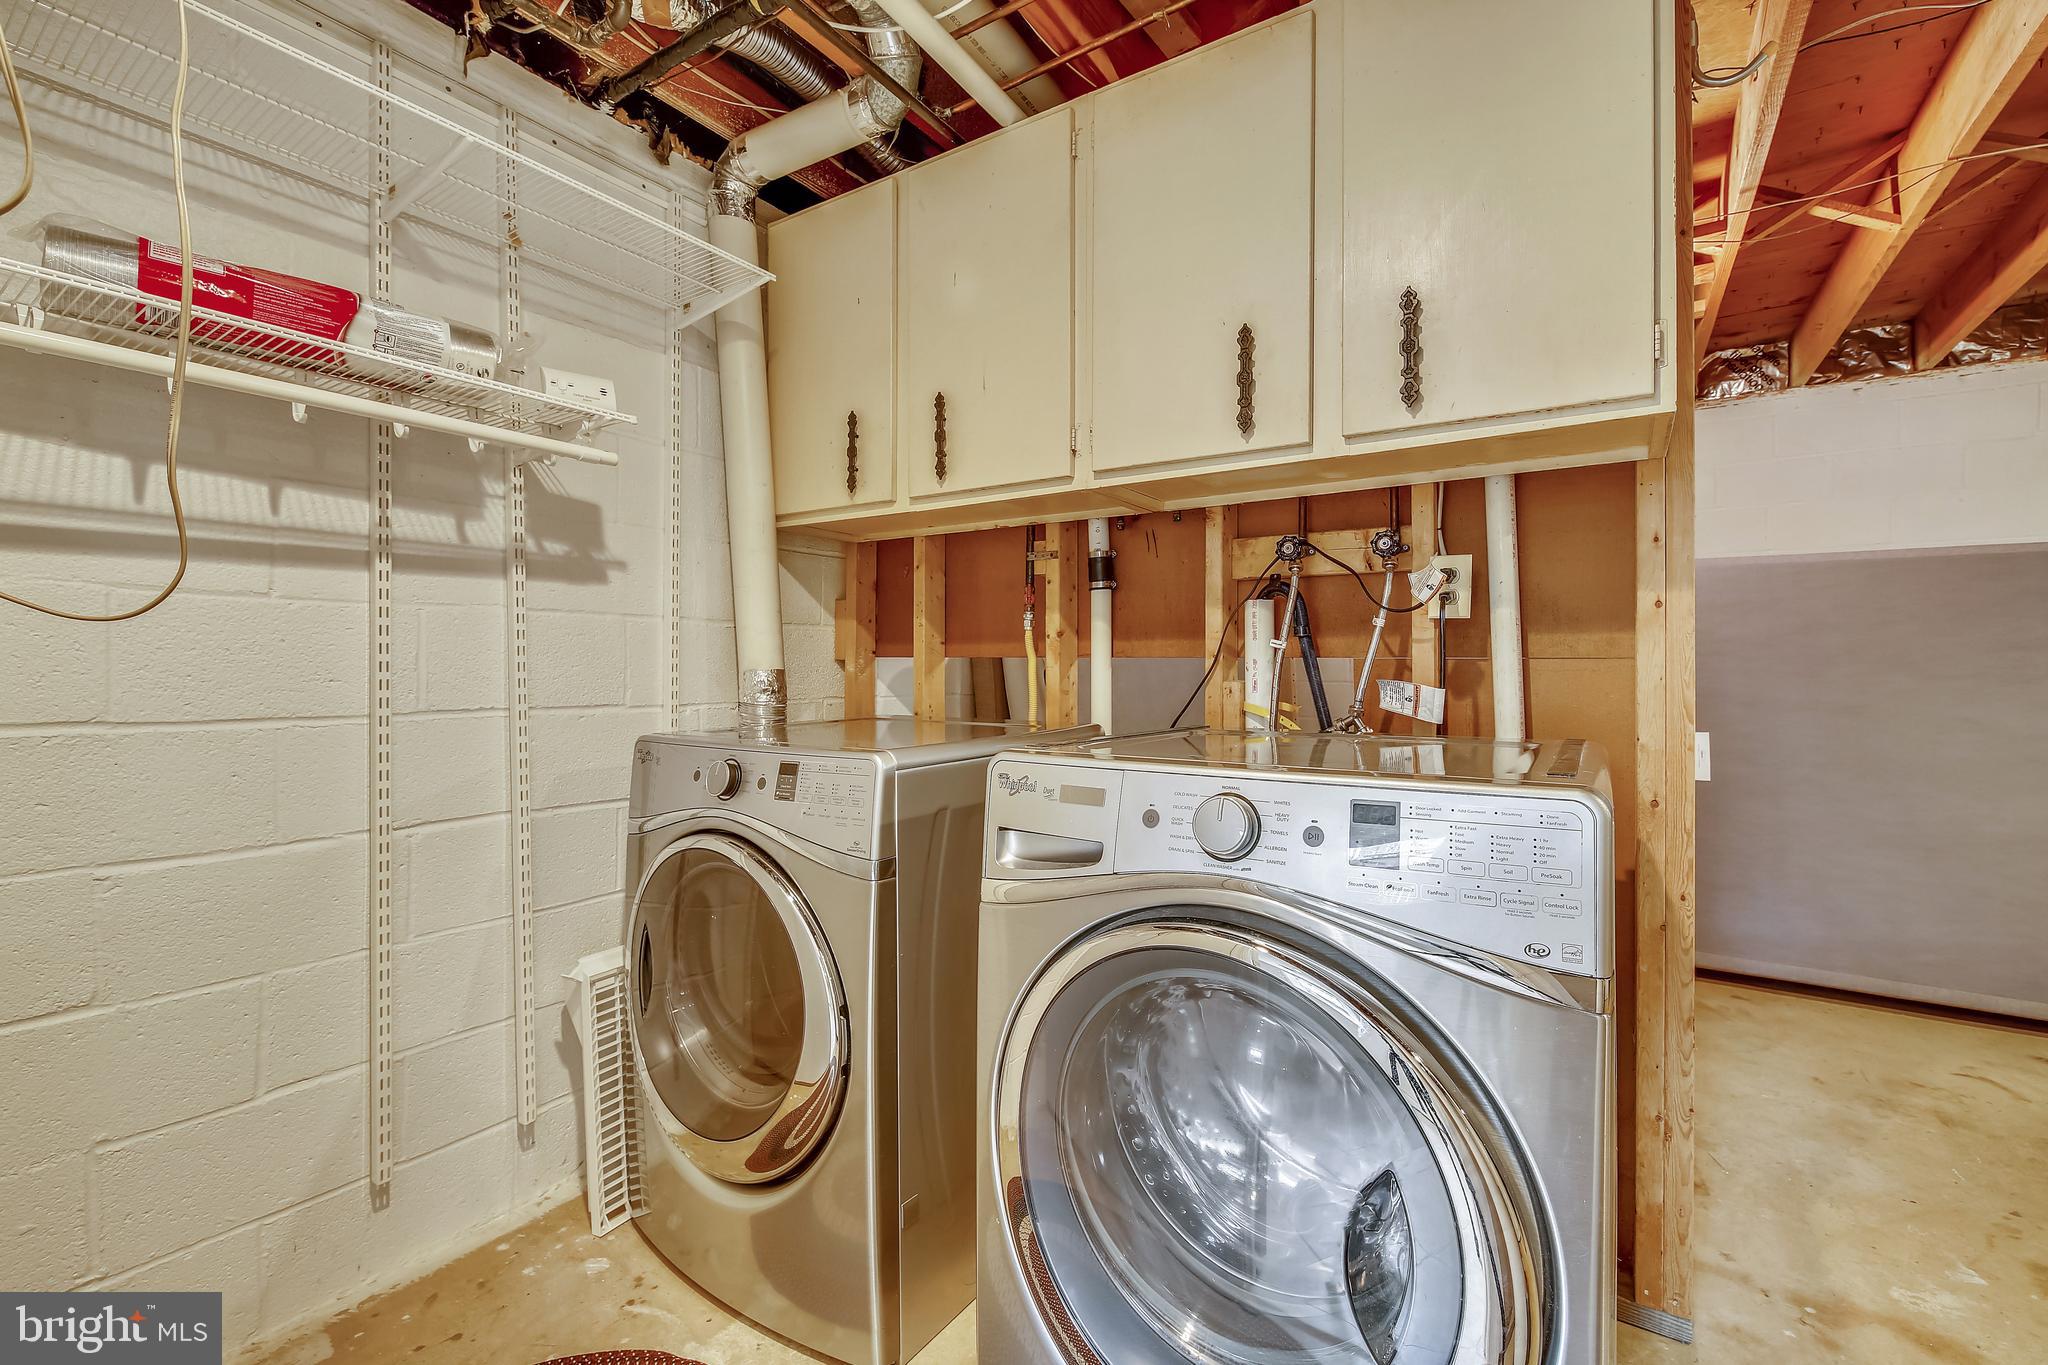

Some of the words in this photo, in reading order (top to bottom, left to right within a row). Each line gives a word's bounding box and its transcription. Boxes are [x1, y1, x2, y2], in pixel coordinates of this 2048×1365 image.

[998, 774, 1038, 797] Whirlpool
[1540, 872, 1563, 880] PreSoak
[1503, 897, 1518, 905] Cycle
[1518, 899, 1535, 907] Signal
[1544, 902, 1565, 910] Control
